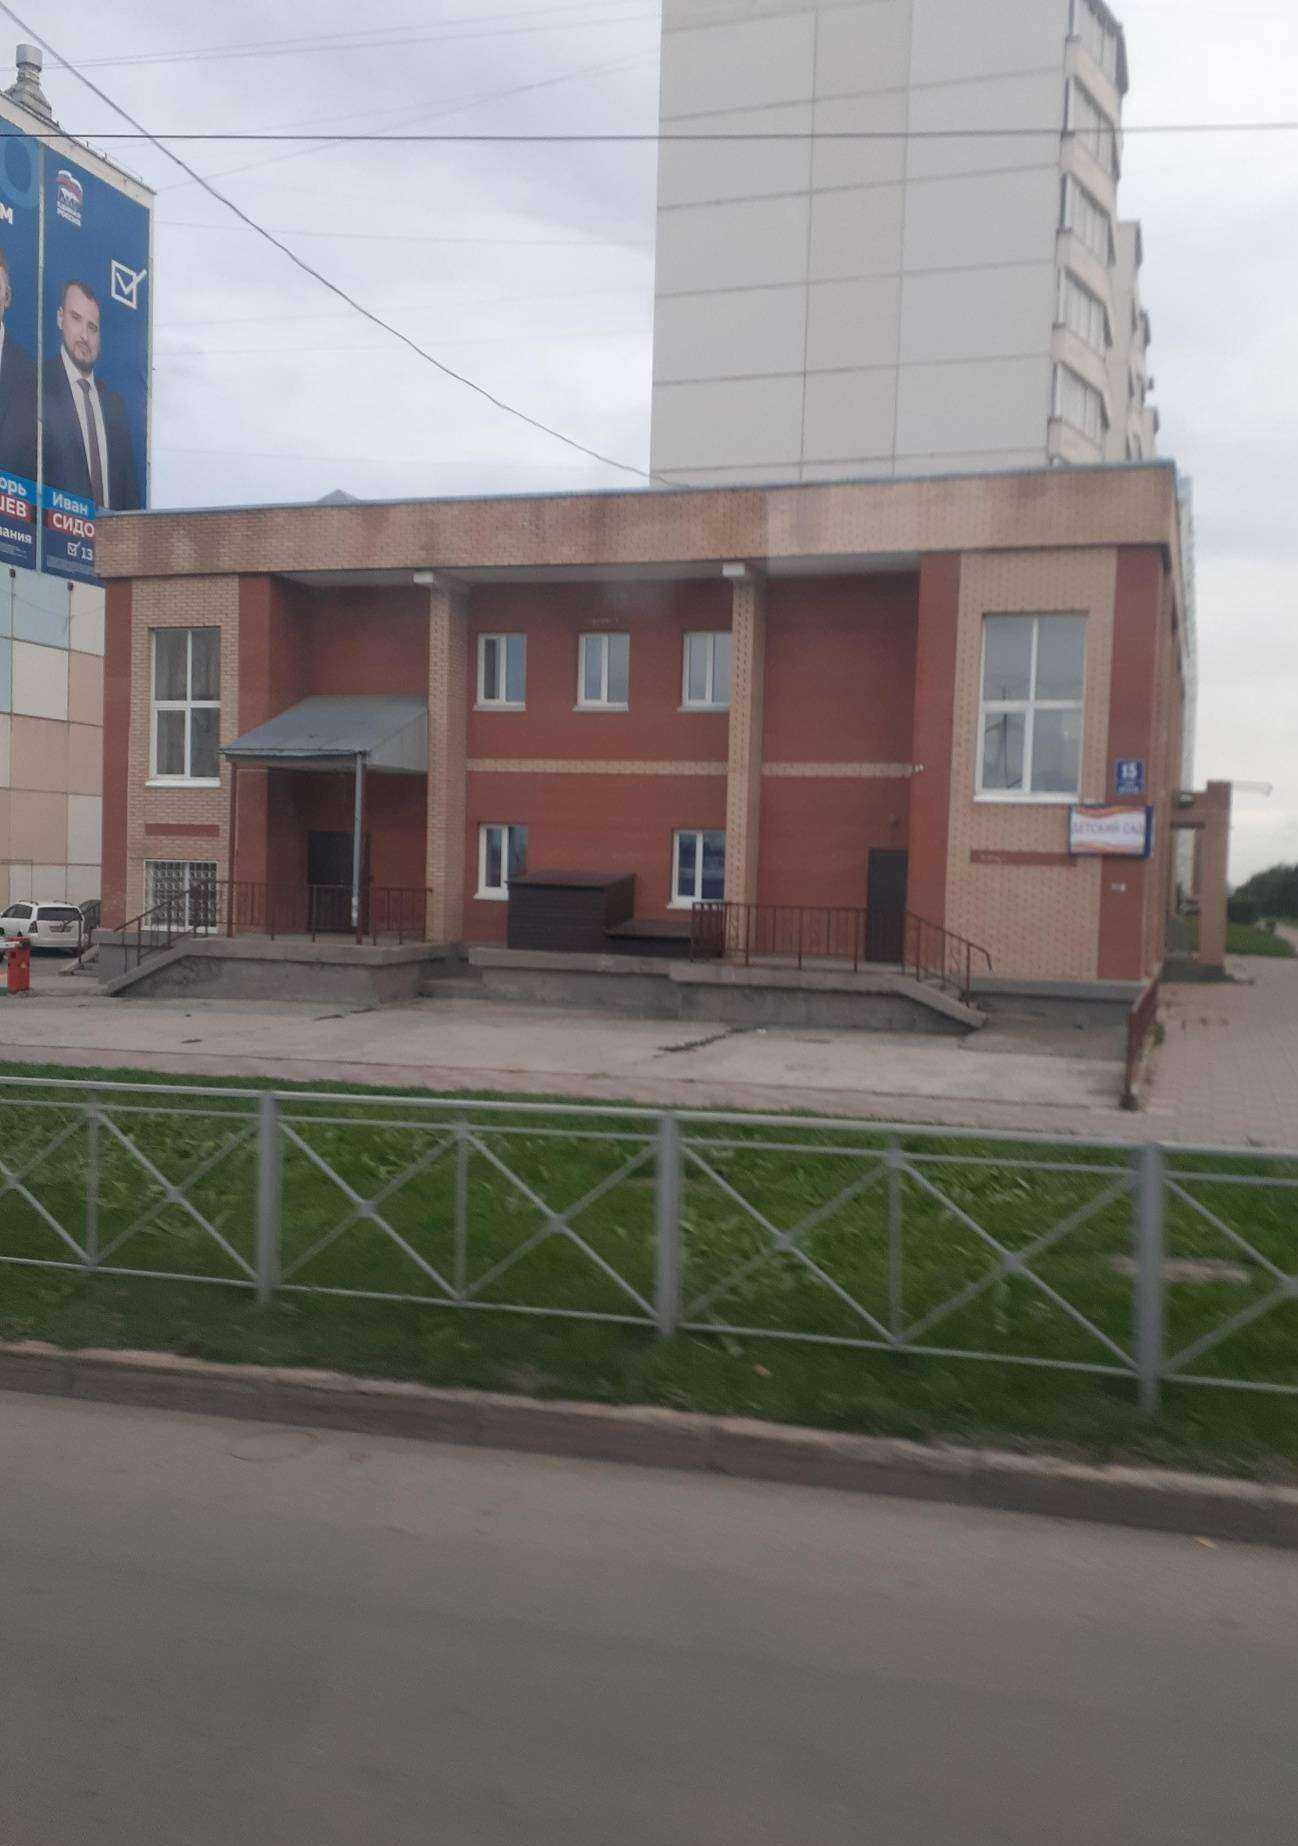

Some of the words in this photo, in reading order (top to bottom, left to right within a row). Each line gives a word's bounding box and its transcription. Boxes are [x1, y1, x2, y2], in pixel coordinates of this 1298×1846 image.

[53, 491, 88, 516] Иван
[53, 513, 95, 538] СИДО
[81, 547, 94, 561] 13
